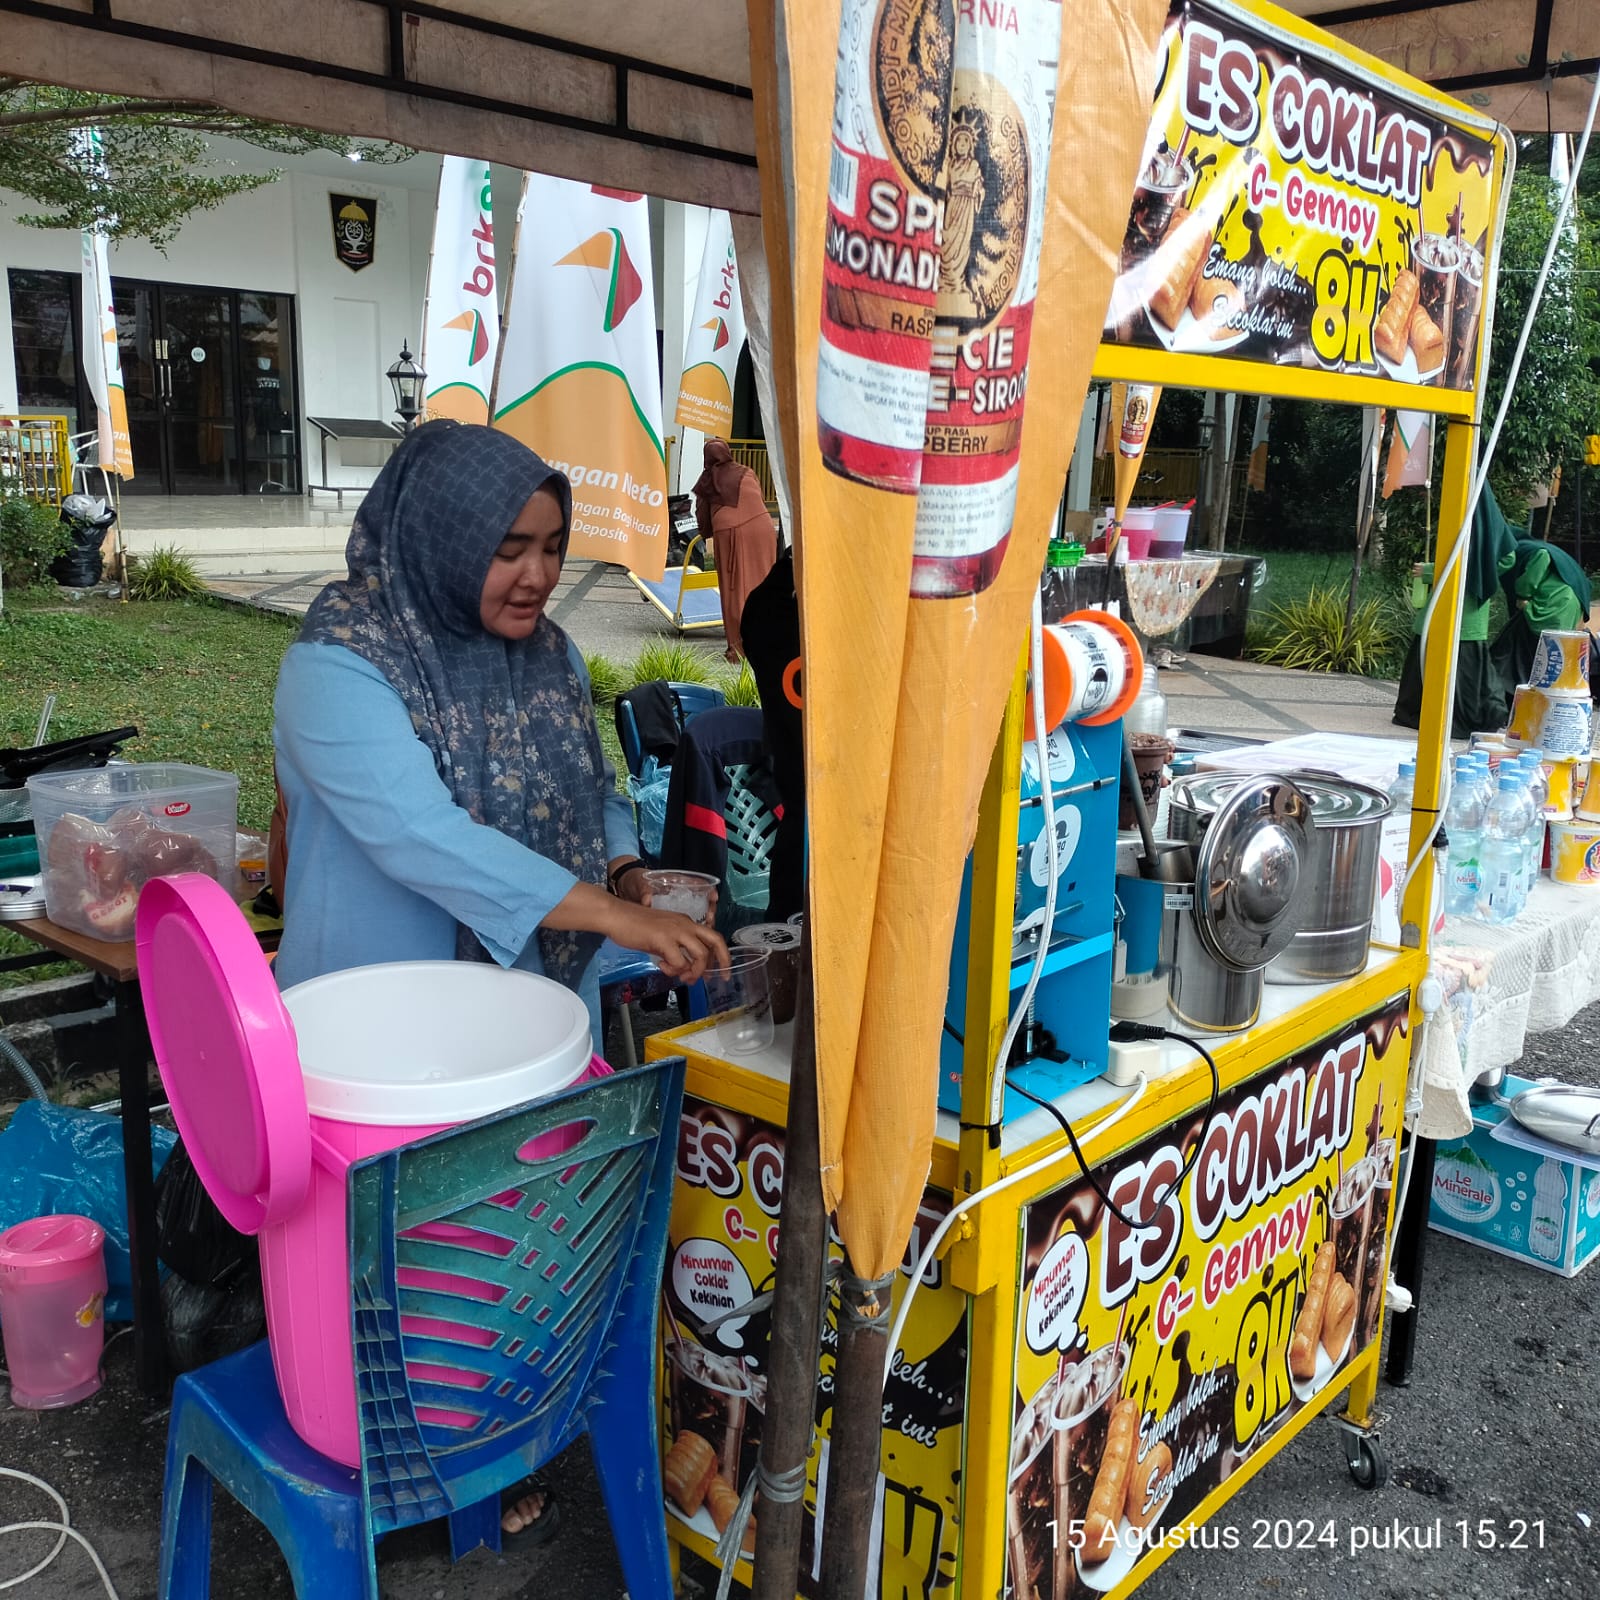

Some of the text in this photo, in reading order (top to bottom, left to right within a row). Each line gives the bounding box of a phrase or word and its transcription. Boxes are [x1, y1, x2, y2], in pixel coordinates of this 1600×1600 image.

[1182, 24, 1429, 206] ES COKLAT
[1286, 176, 1377, 248] Gemoy
[827, 222, 941, 293] MONAD
[1203, 243, 1256, 288] Emang
[1209, 295, 1296, 339] Secoklat ini
[928, 365, 1029, 415] E-SIROO
[944, 426, 969, 436] RASA
[621, 472, 663, 507] Neto
[571, 519, 629, 544] Deposito
[677, 1113, 740, 1195] ES
[1103, 1037, 1366, 1303] ES COKLAT
[1435, 1175, 1492, 1204] Minerale
[1455, 1170, 1471, 1186] Le
[680, 1253, 734, 1273] Minuman
[1034, 1243, 1076, 1301] Minuman
[1204, 1193, 1315, 1306] Gemoy
[689, 1288, 735, 1309] Kekinian
[694, 1272, 729, 1291] Coklat
[1043, 1268, 1071, 1310] Coklat
[1038, 1285, 1075, 1337] Kekinian
[1137, 1401, 1182, 1464] Emang
[1141, 1423, 1221, 1515] Secoklat ini
